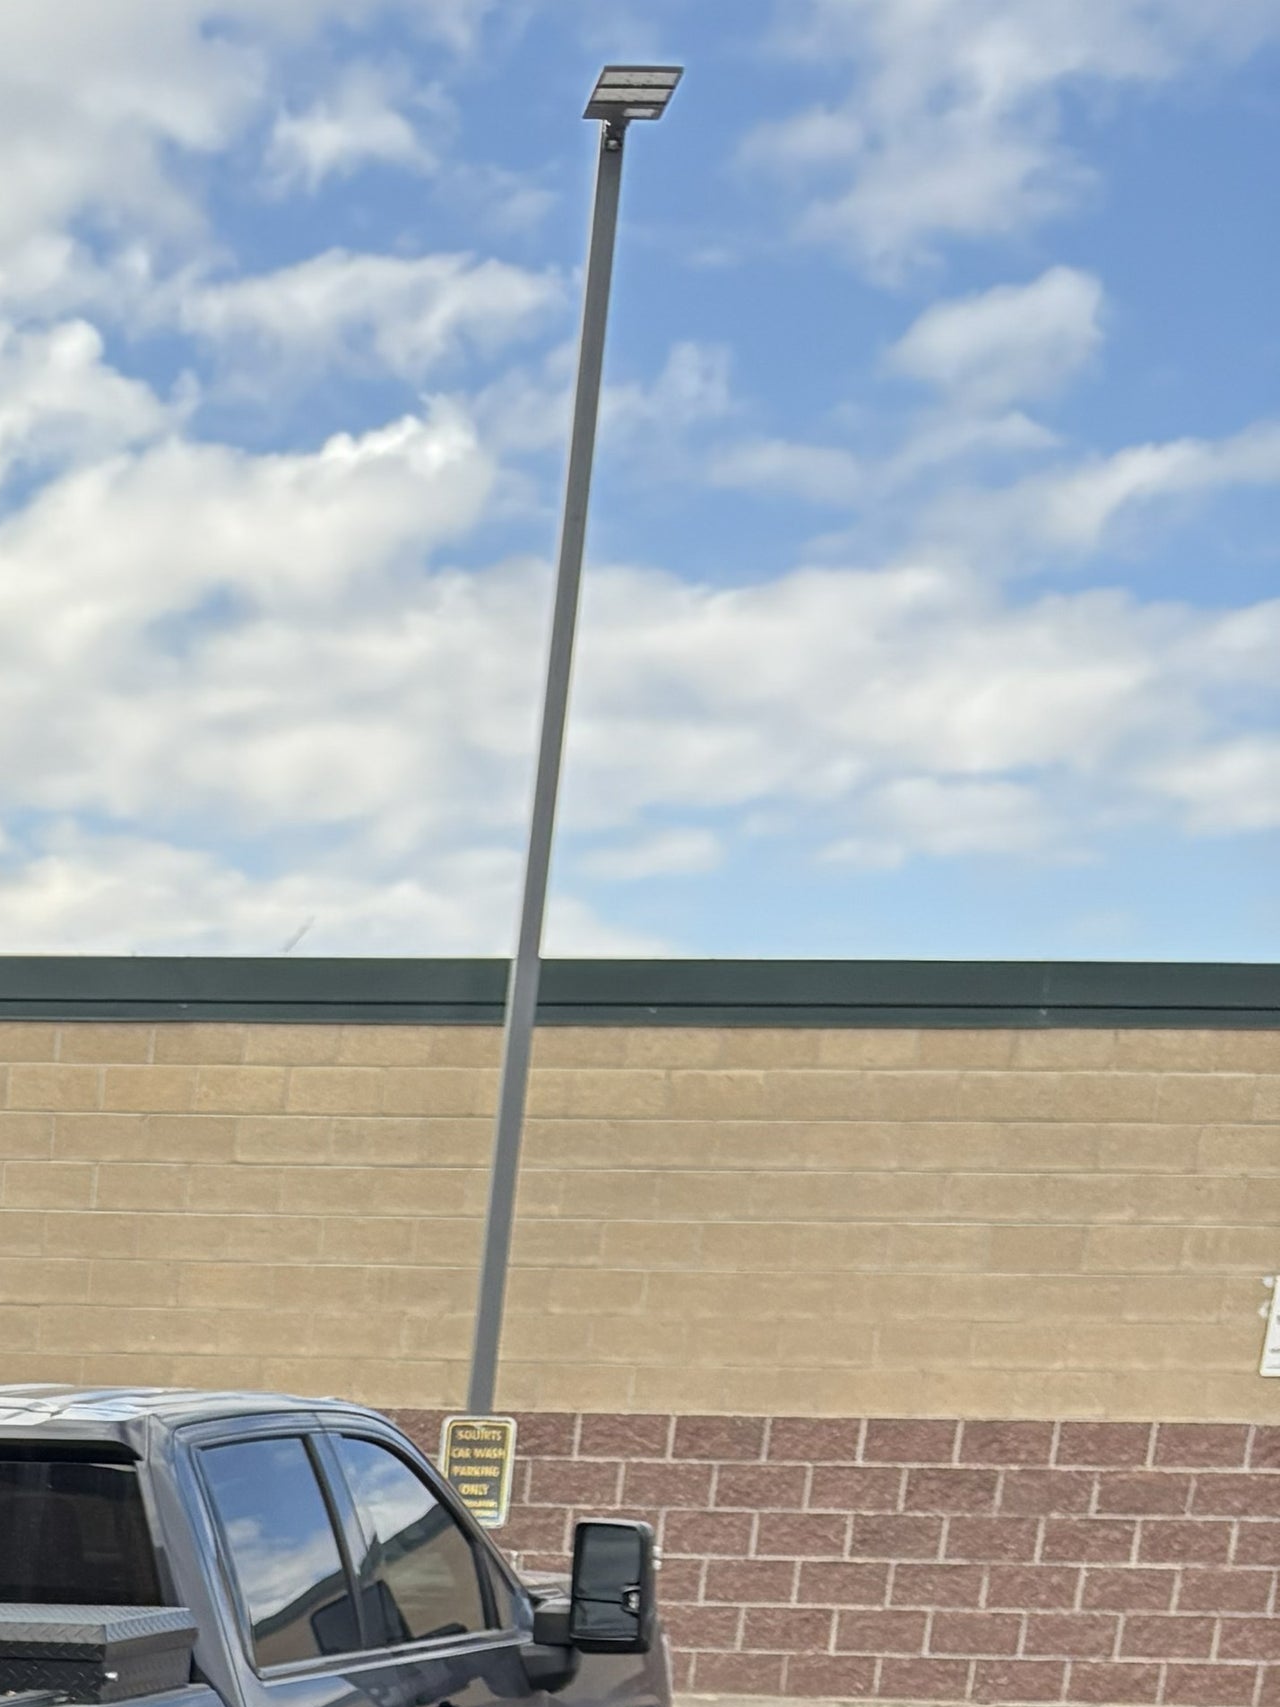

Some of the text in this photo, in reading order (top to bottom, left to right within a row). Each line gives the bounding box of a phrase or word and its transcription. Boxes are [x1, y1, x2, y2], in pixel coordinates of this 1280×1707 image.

[451, 1446, 505, 1459] CAR WASH
[451, 1465, 500, 1478] PARKING
[458, 1482, 490, 1496] ONLY
